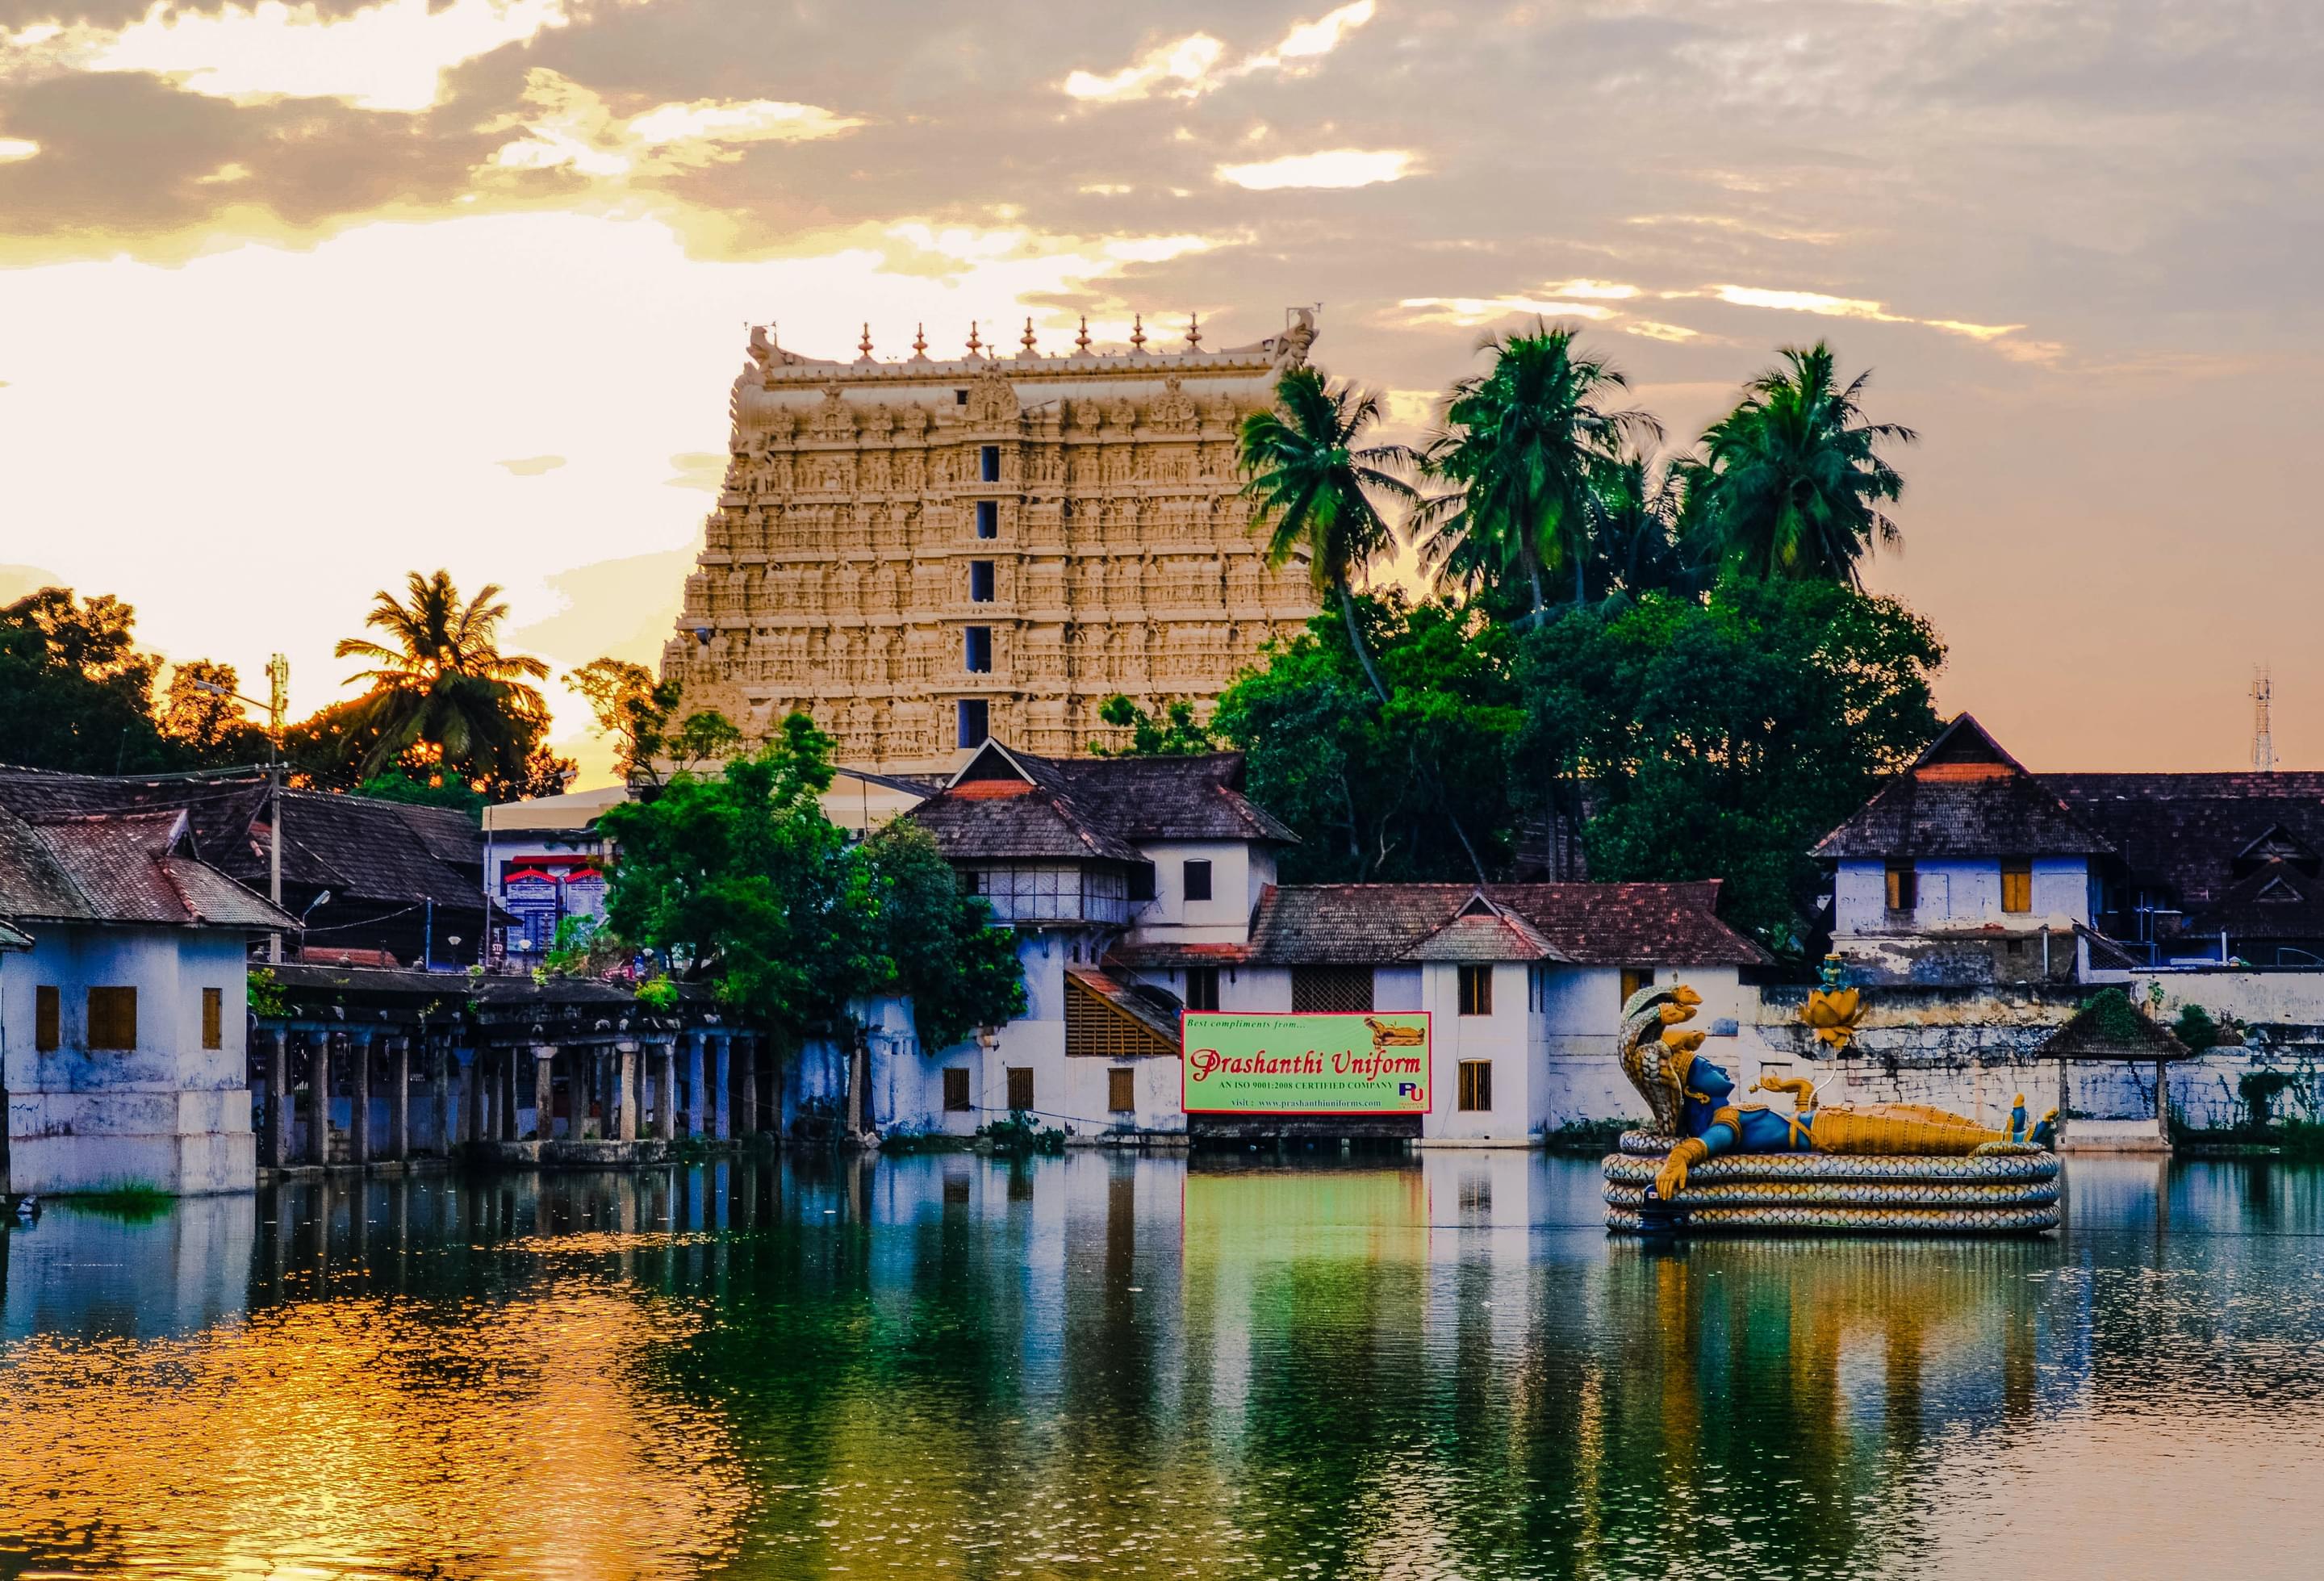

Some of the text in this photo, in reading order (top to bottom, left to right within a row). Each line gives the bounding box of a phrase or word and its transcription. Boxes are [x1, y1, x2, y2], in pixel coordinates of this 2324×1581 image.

[1187, 1018, 1306, 1030] Best compliments from...
[1190, 1048, 1421, 1082] Prashanthi Uniform
[1218, 1081, 1393, 1090] AN ISO 9001:2008 CERTIFIED COMPANY
[1259, 1098, 1381, 1108] www.prashanthiuniforms.com
